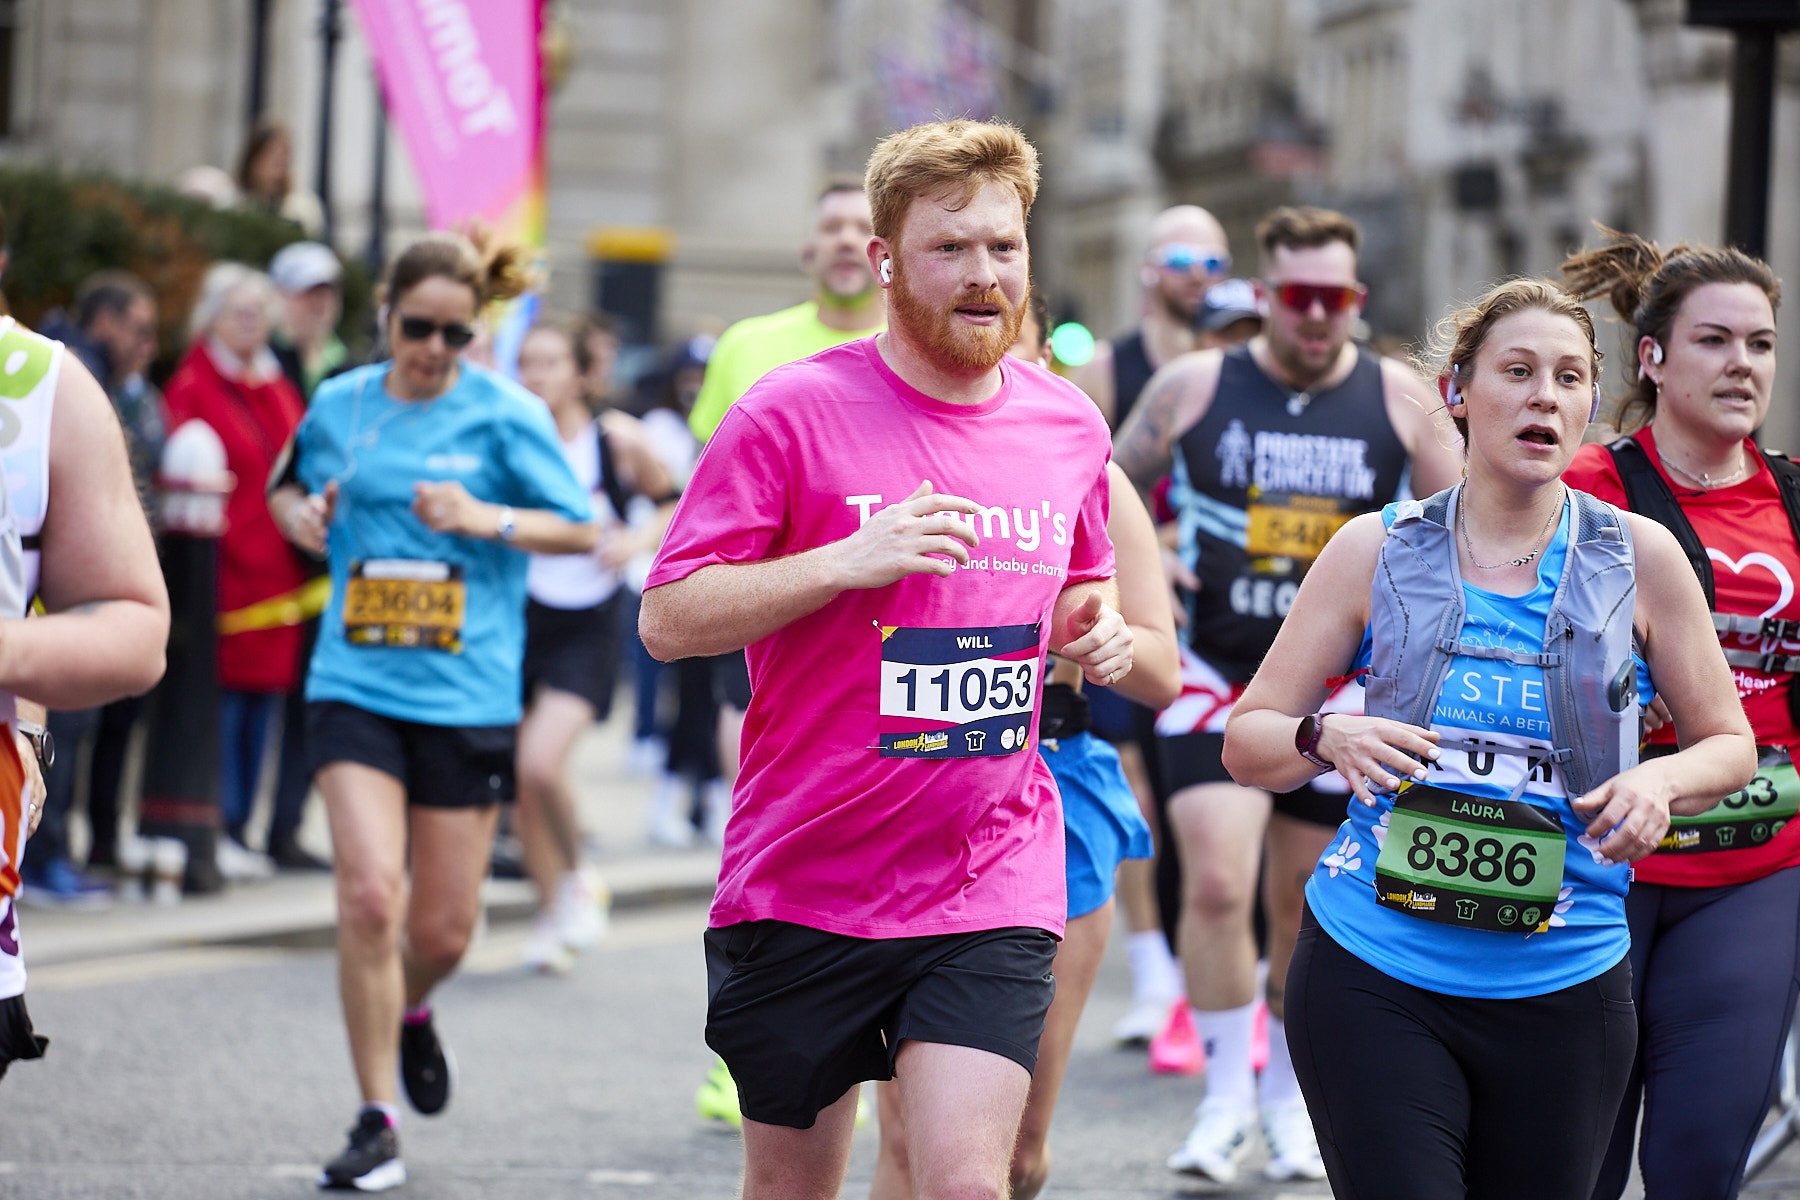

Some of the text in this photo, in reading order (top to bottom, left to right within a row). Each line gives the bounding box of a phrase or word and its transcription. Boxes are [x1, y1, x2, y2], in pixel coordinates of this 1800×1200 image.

[846, 494, 1067, 552] Tmy's
[993, 555, 1029, 575] baby
[956, 635, 993, 649] WILL
[896, 663, 1032, 712] 11053
[1732, 670, 1777, 690] Heart
[1433, 704, 1496, 725] NIMALS
[1500, 715, 1511, 728] A
[1451, 799, 1505, 821] LAURA
[1406, 825, 1538, 888] 8386
[1463, 906, 1469, 915] S
